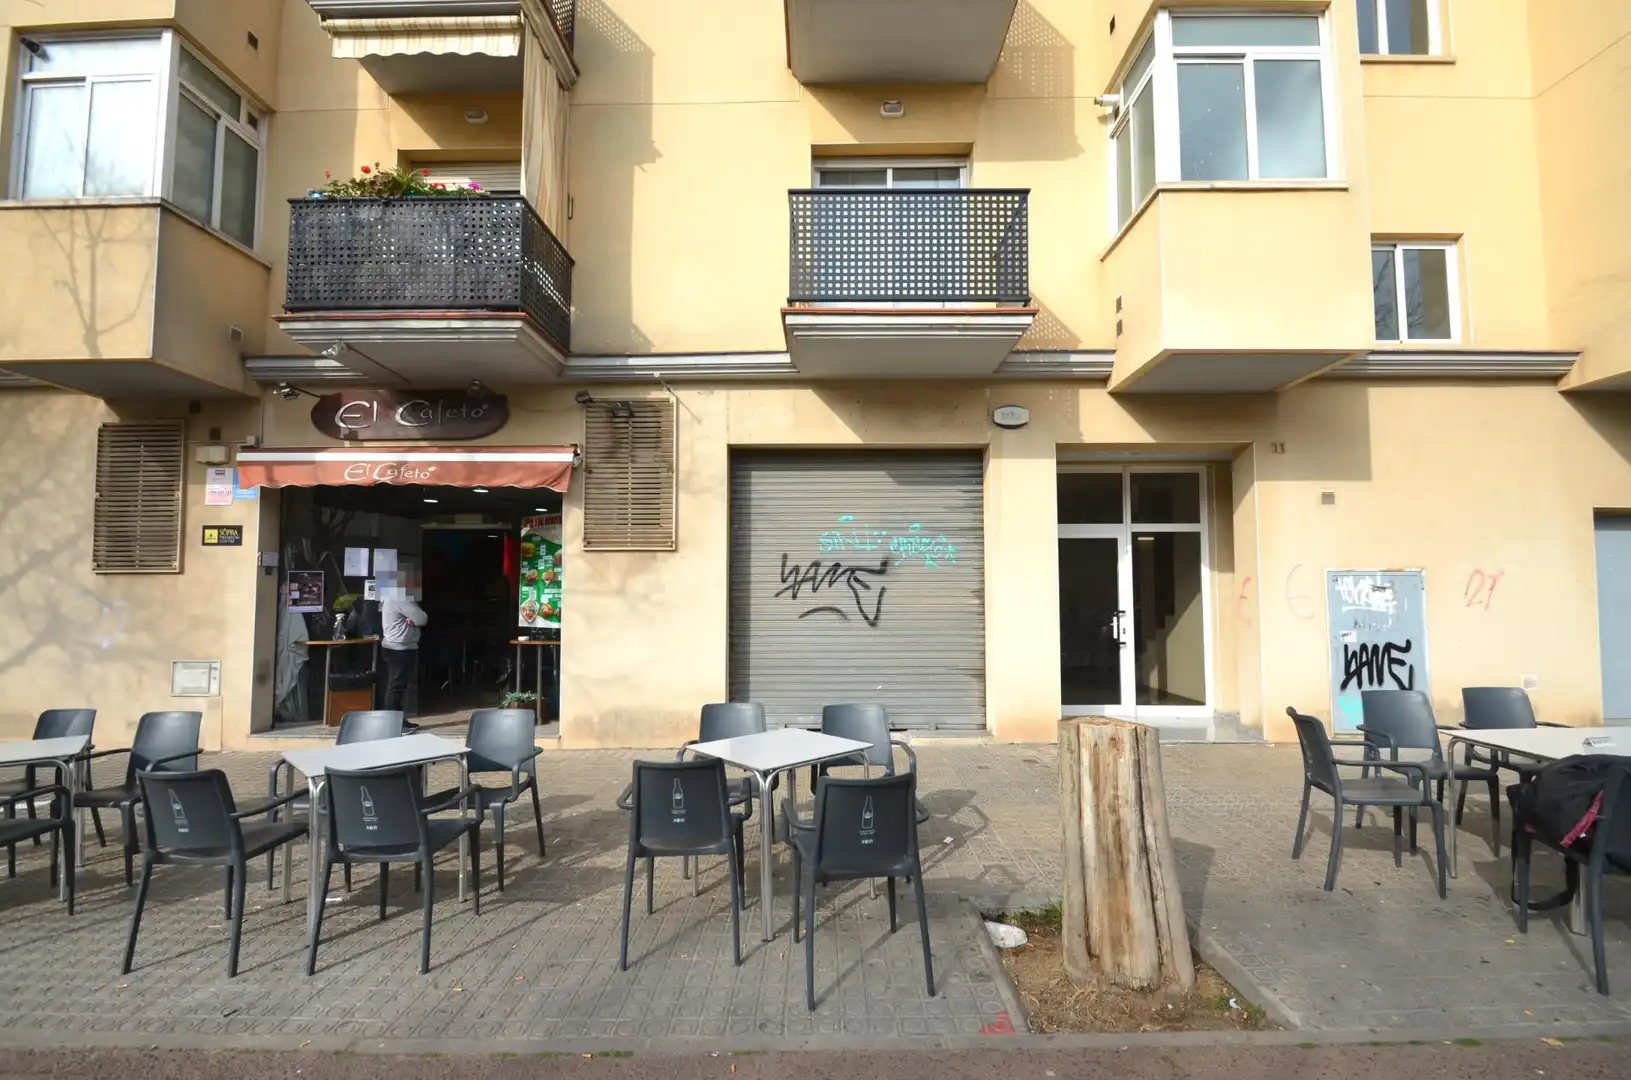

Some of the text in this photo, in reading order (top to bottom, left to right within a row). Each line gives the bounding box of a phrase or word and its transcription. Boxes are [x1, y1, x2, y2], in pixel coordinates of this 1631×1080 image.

[334, 399, 486, 429] El Cafeto
[343, 463, 433, 482] El Cafeto
